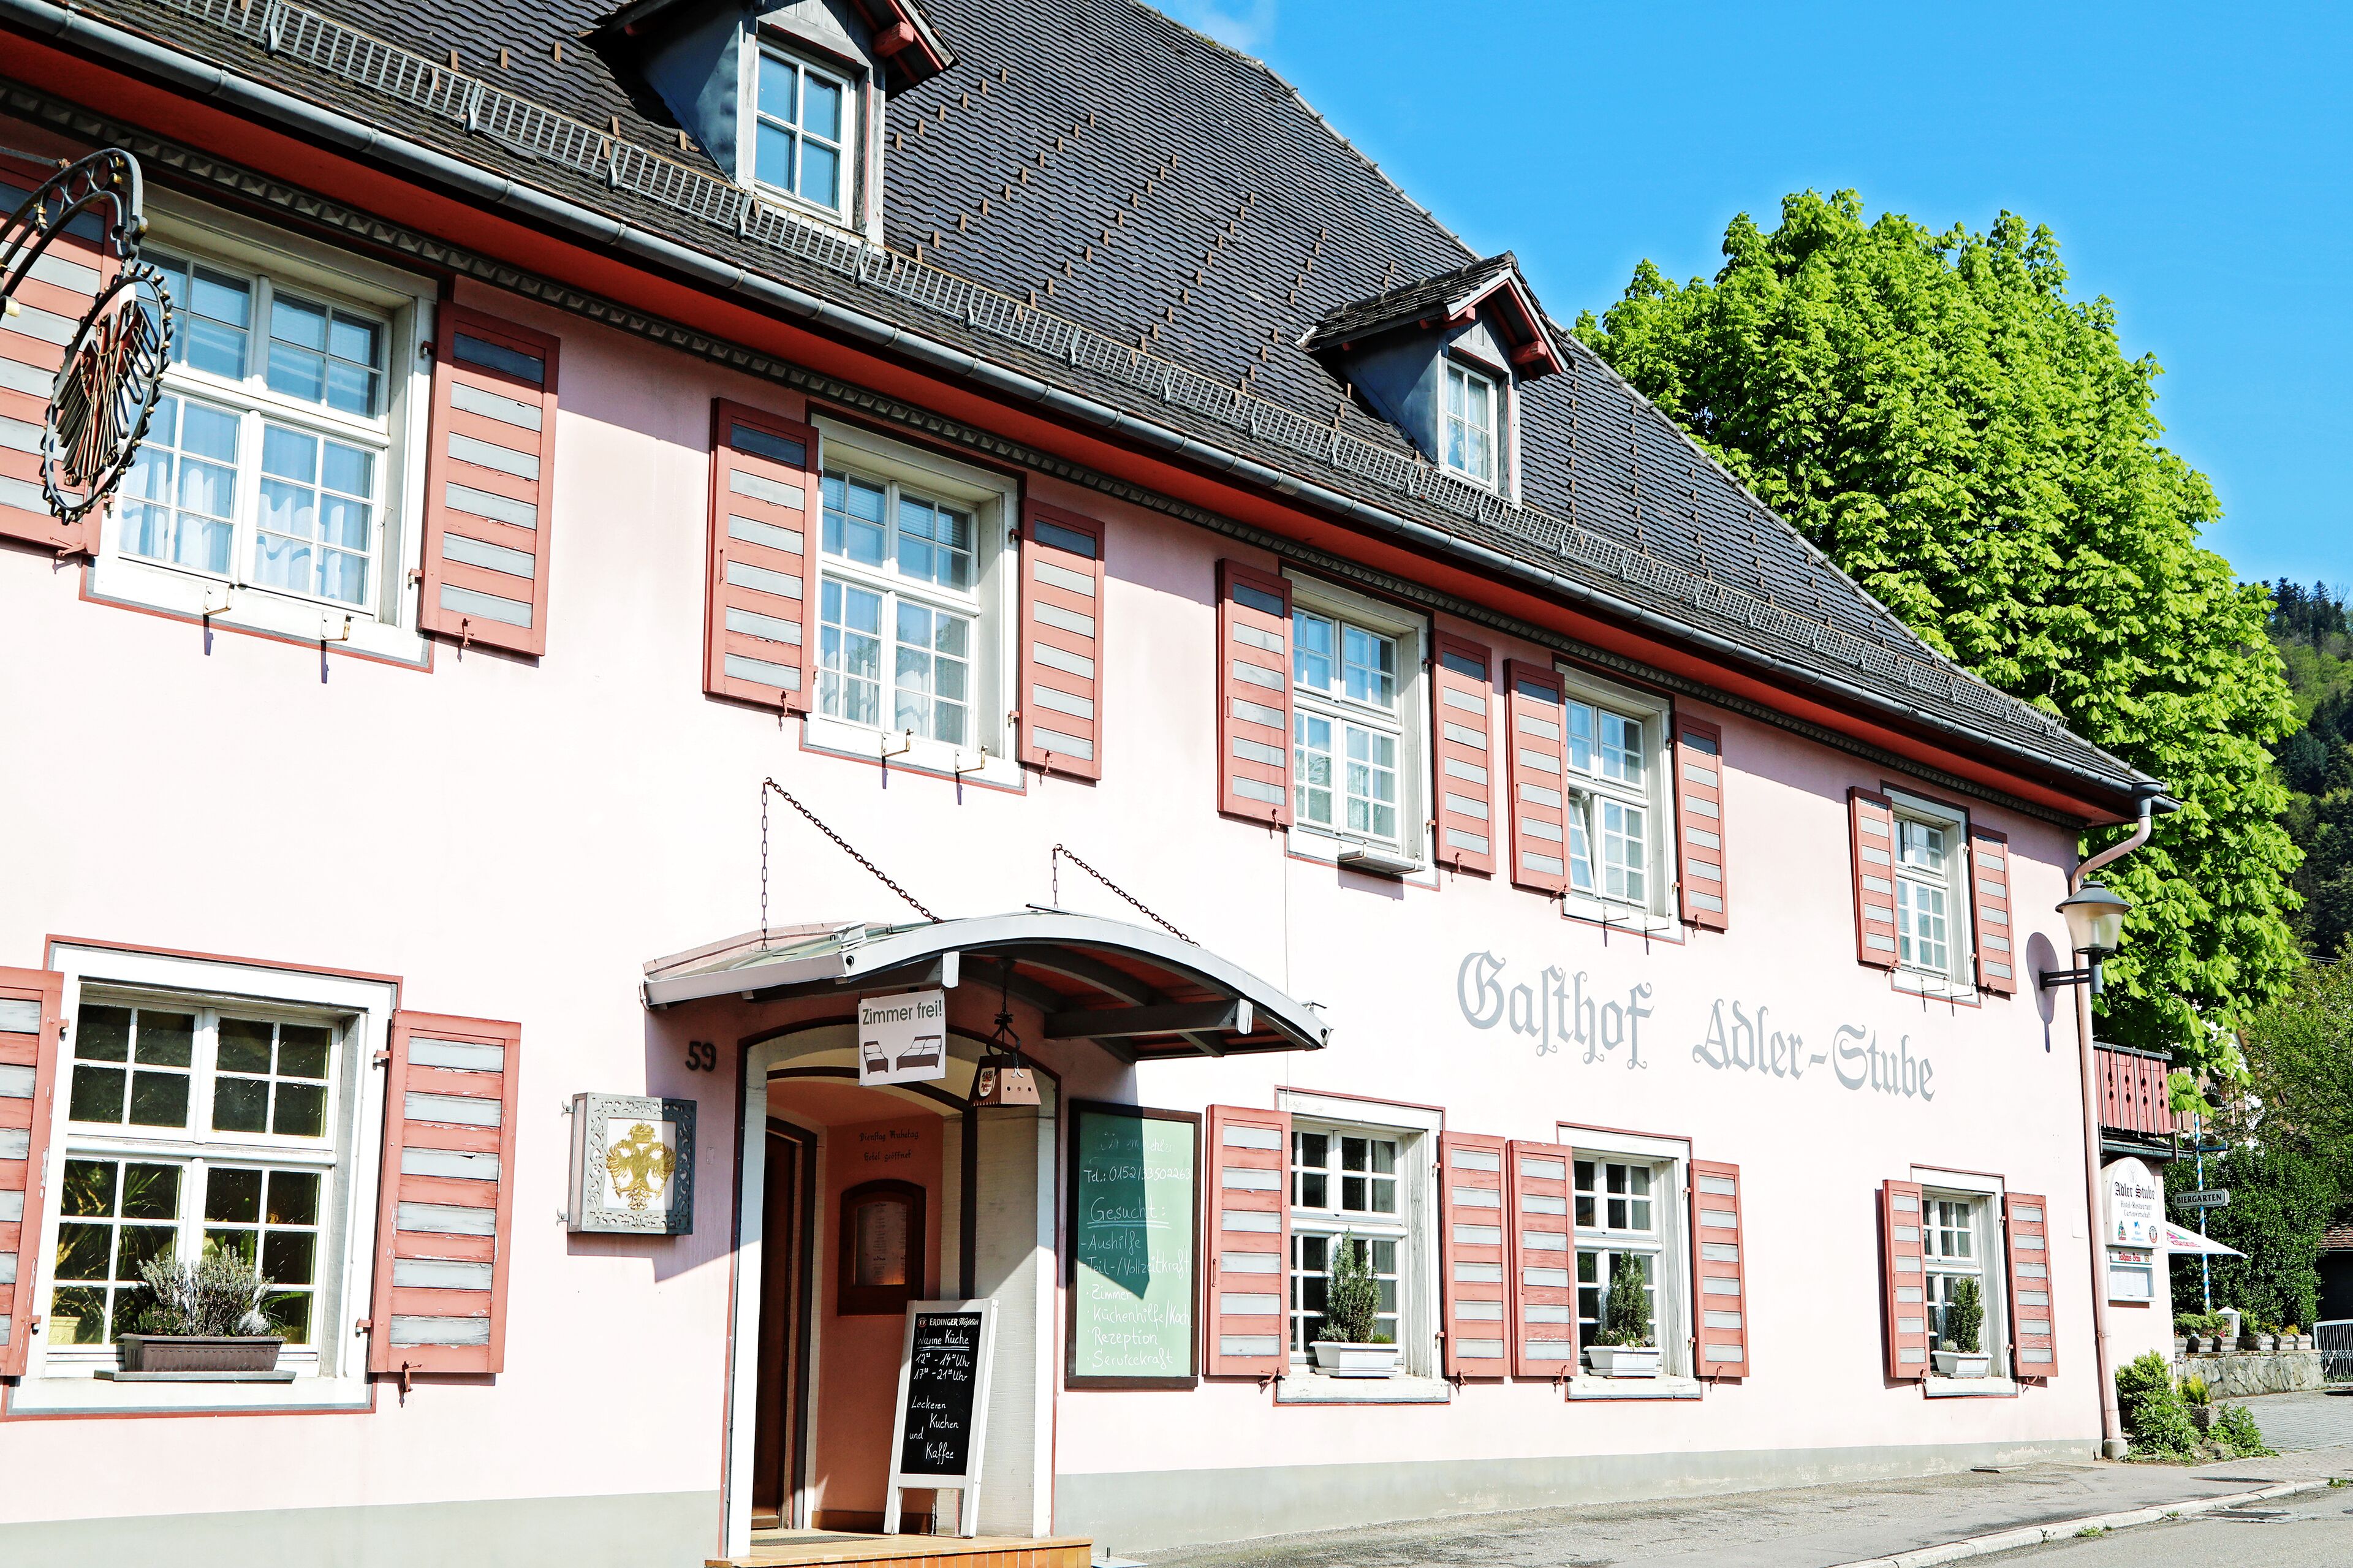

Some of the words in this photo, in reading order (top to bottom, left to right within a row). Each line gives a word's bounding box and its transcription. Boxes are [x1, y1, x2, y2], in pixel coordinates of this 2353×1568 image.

[862, 1007, 913, 1025] Zimmer
[917, 1000, 942, 1019] frei!
[685, 1040, 716, 1072] 59
[1692, 998, 1936, 1102] Adler-Stube
[1084, 1169, 1106, 1183] Tel.:
[2114, 1181, 2133, 1197] Adler
[2135, 1184, 2155, 1200] Stube
[2177, 1194, 2222, 1204] BIERGARTEN
[1091, 1284, 1132, 1300] Zimmer
[929, 1318, 958, 1327] ERDINGER
[945, 1329, 969, 1344] Küche
[1091, 1327, 1158, 1351] Rezeption
[955, 1354, 971, 1367] Uhr
[1093, 1347, 1173, 1369] Servicekraft
[952, 1369, 968, 1381] Uhr
[911, 1395, 946, 1409] Leckeren
[929, 1412, 959, 1428] Kuchen
[909, 1426, 924, 1439] und
[925, 1441, 954, 1464] Kaffee
